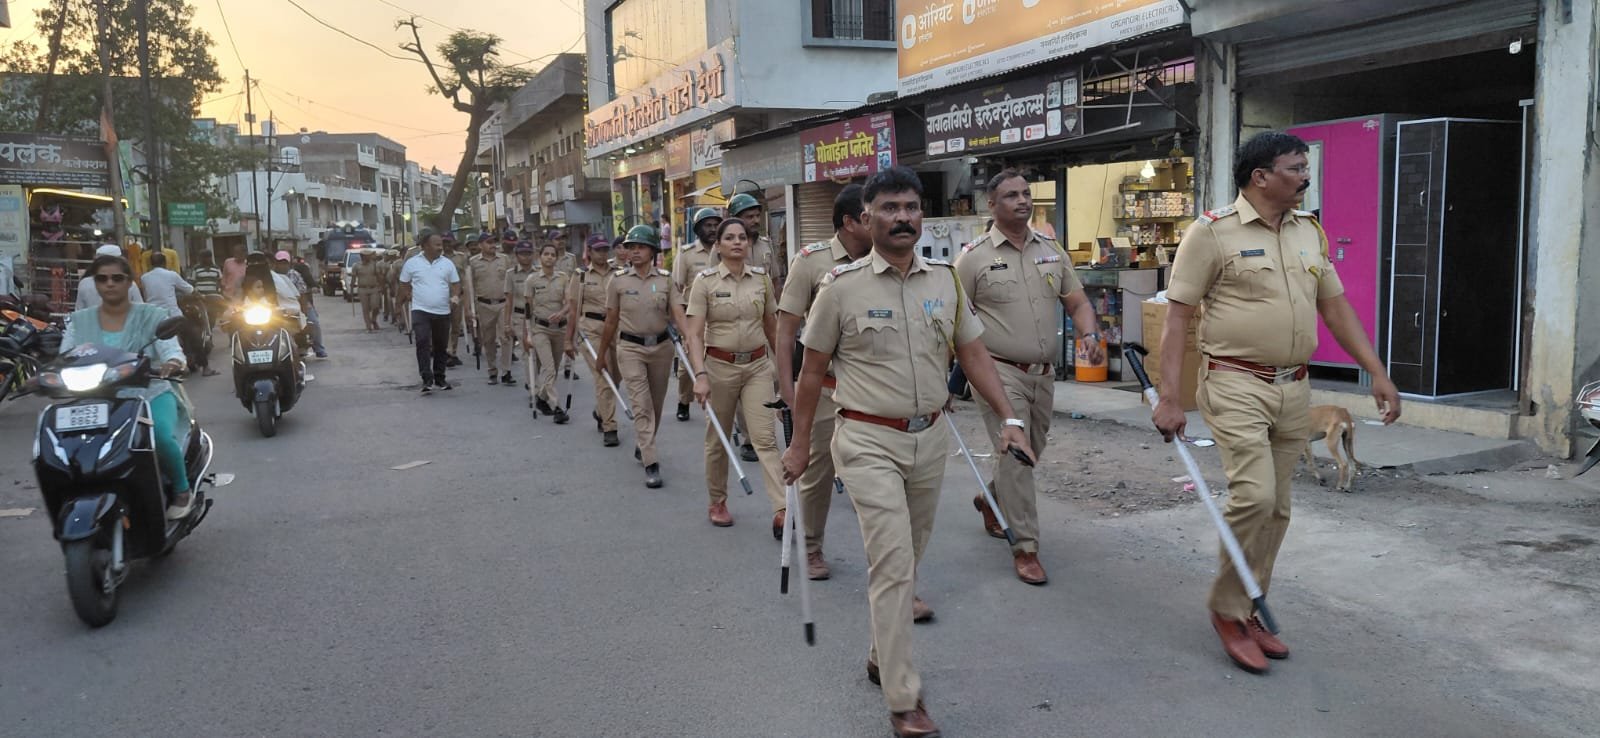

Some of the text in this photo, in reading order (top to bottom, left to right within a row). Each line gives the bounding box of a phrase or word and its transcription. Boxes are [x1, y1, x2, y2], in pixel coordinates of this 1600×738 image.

[1111, 14, 1141, 29] GAGANGIRI
[1142, 3, 1180, 20] ELECTRICALS
[926, 103, 973, 135] गगनगिरी
[816, 137, 849, 166] मोबाईल
[70, 405, 99, 416] MH53
